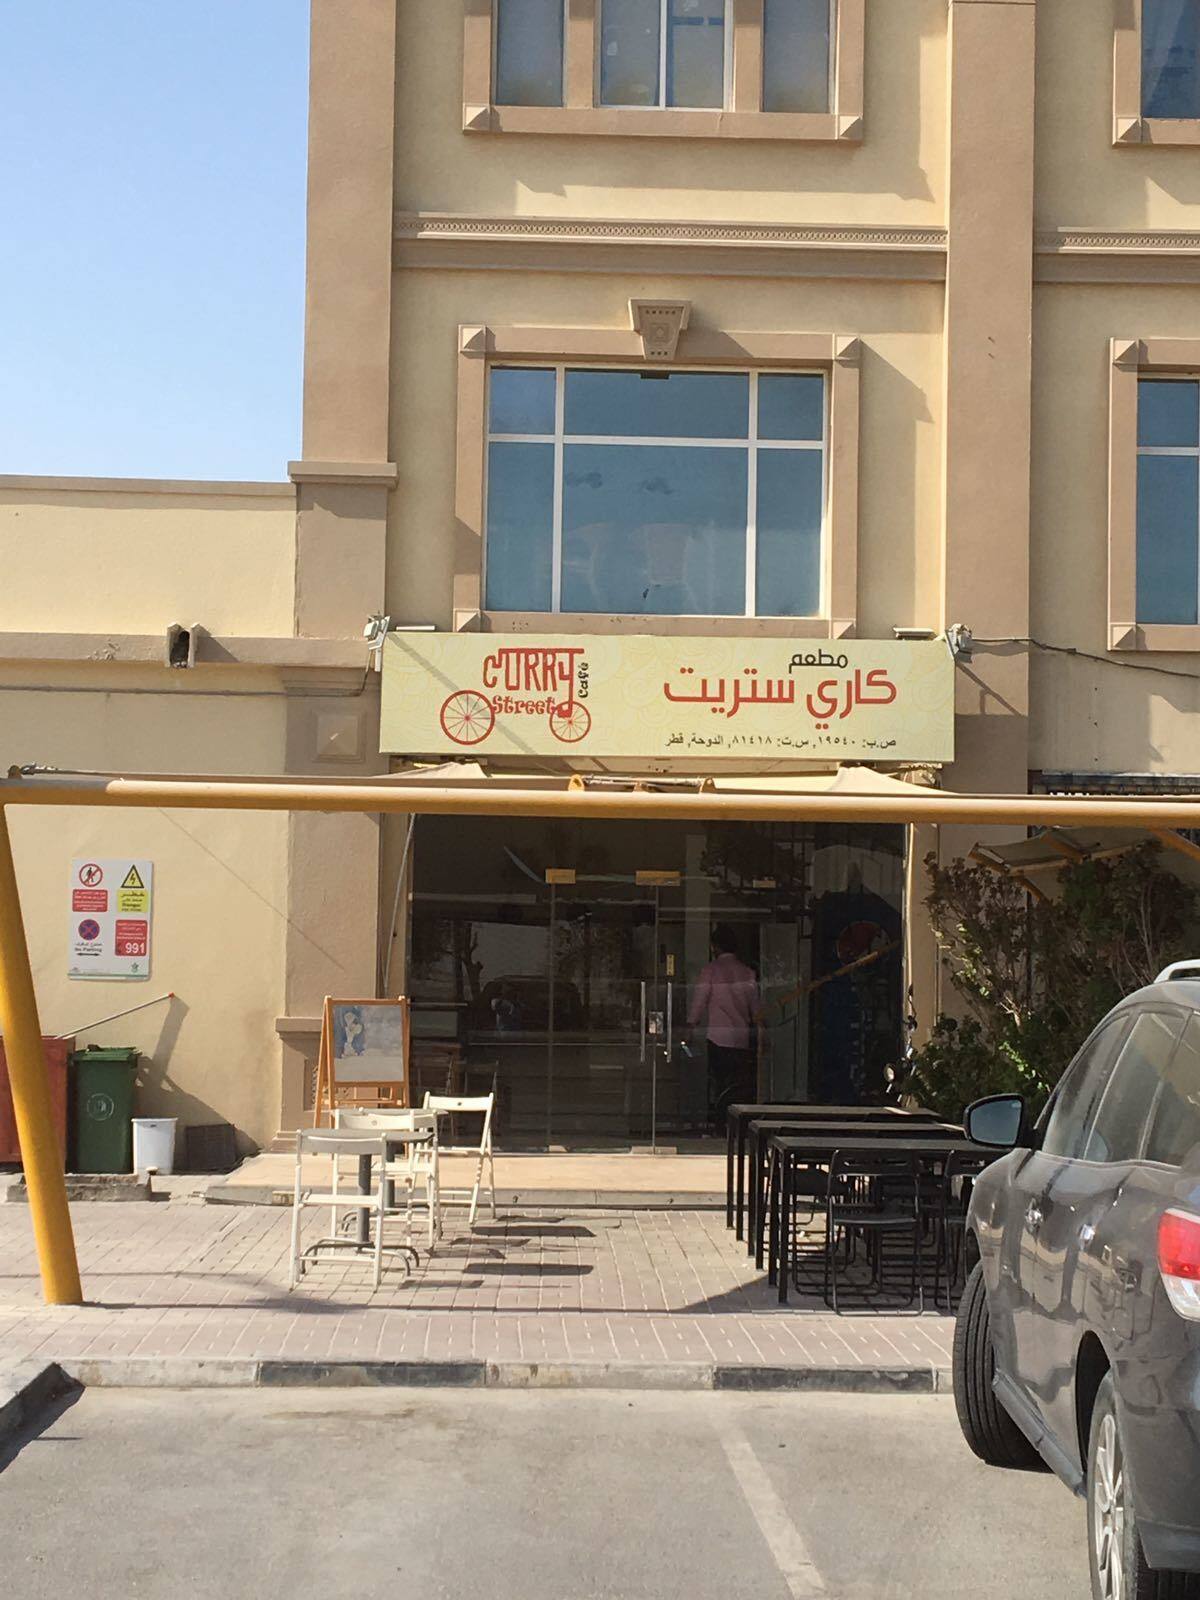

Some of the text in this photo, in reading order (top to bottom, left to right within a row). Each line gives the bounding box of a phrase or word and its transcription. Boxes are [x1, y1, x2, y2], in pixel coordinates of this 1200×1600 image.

[789, 648, 849, 673] مطعم
[482, 647, 585, 718] CURRY
[491, 694, 558, 715] Street
[663, 667, 898, 730] كاري ستريت
[664, 733, 686, 747] قطر
[125, 942, 145, 953] 991
